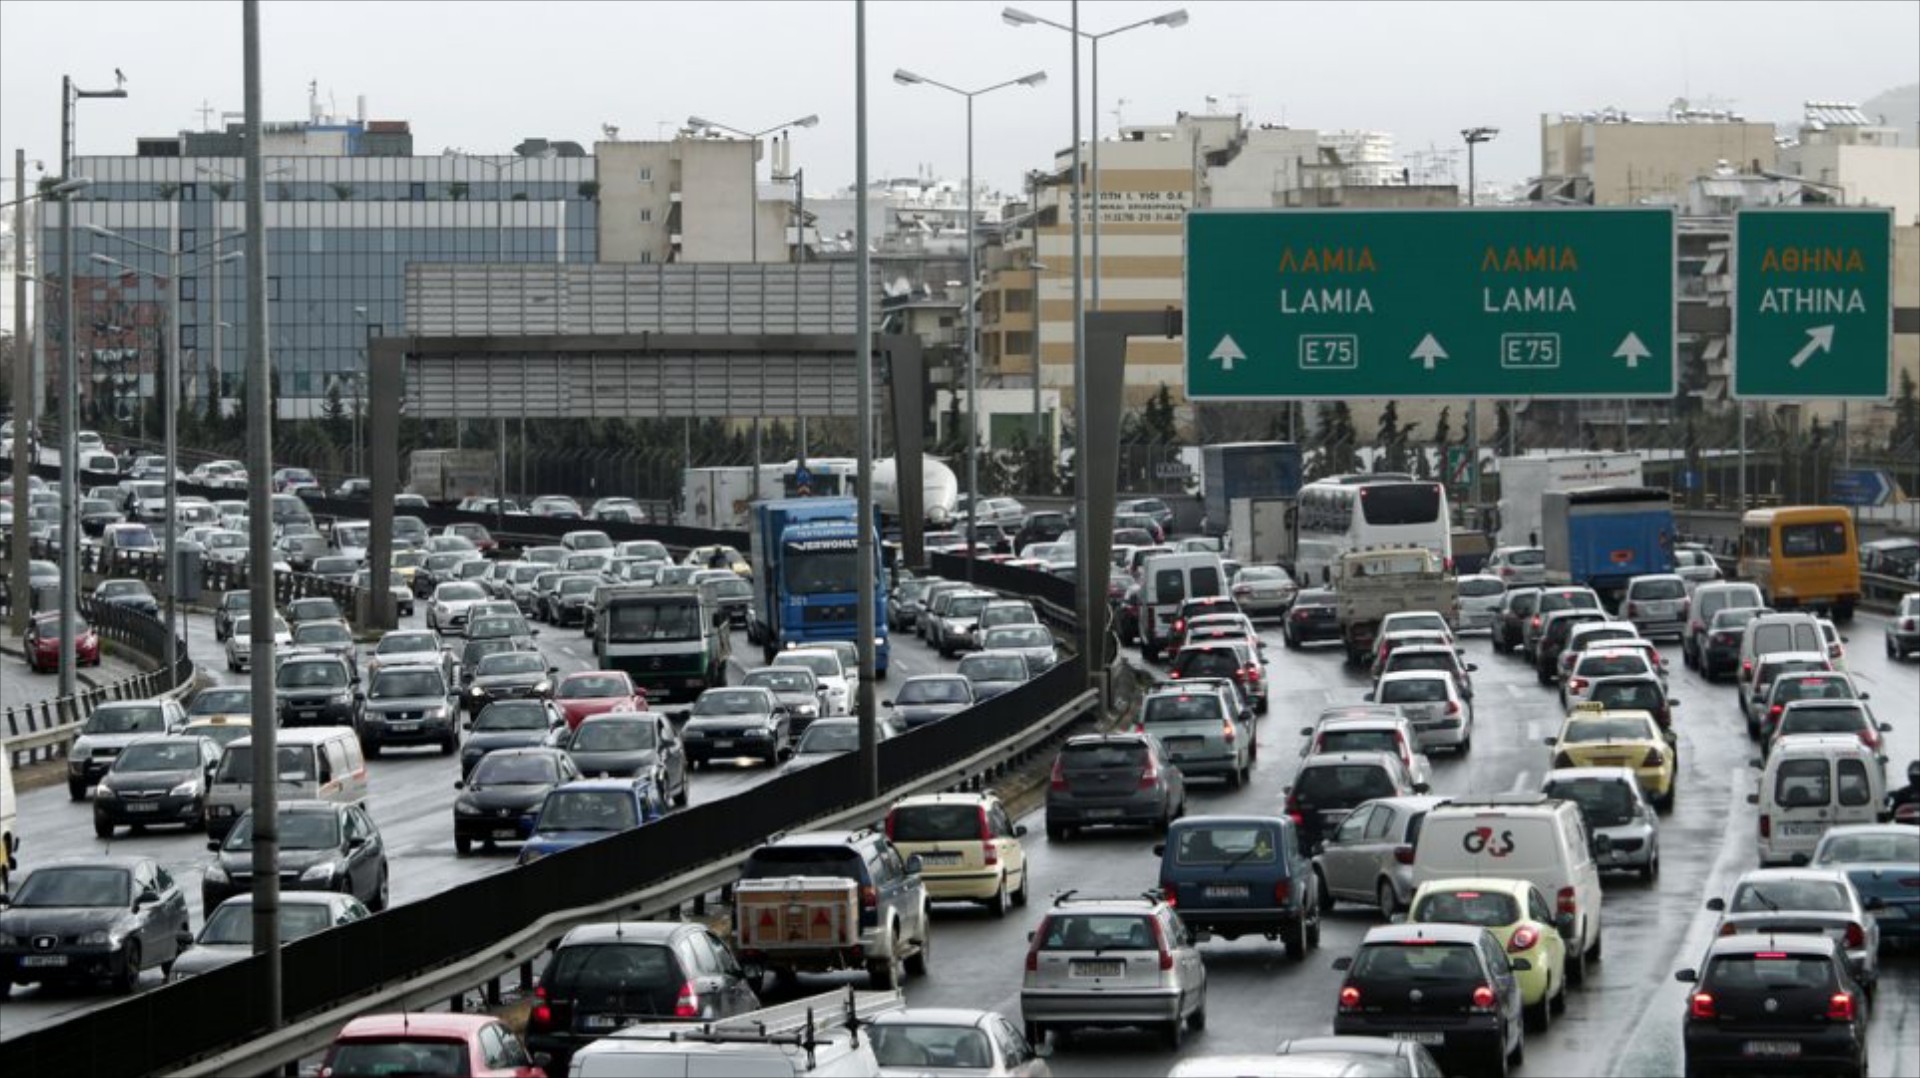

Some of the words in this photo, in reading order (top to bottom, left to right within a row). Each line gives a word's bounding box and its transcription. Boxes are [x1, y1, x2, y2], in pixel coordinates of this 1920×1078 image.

[1279, 246, 1376, 273] ΛΑΜΙΑ
[1481, 246, 1578, 272] ΛΑΜΙΑ
[1761, 246, 1864, 272] ΑΘΗΝΑ
[1281, 288, 1374, 313] LAMIA
[1483, 287, 1577, 312] LAMIA
[1759, 288, 1866, 313] ATHINA
[1463, 827, 1514, 857] G4S
